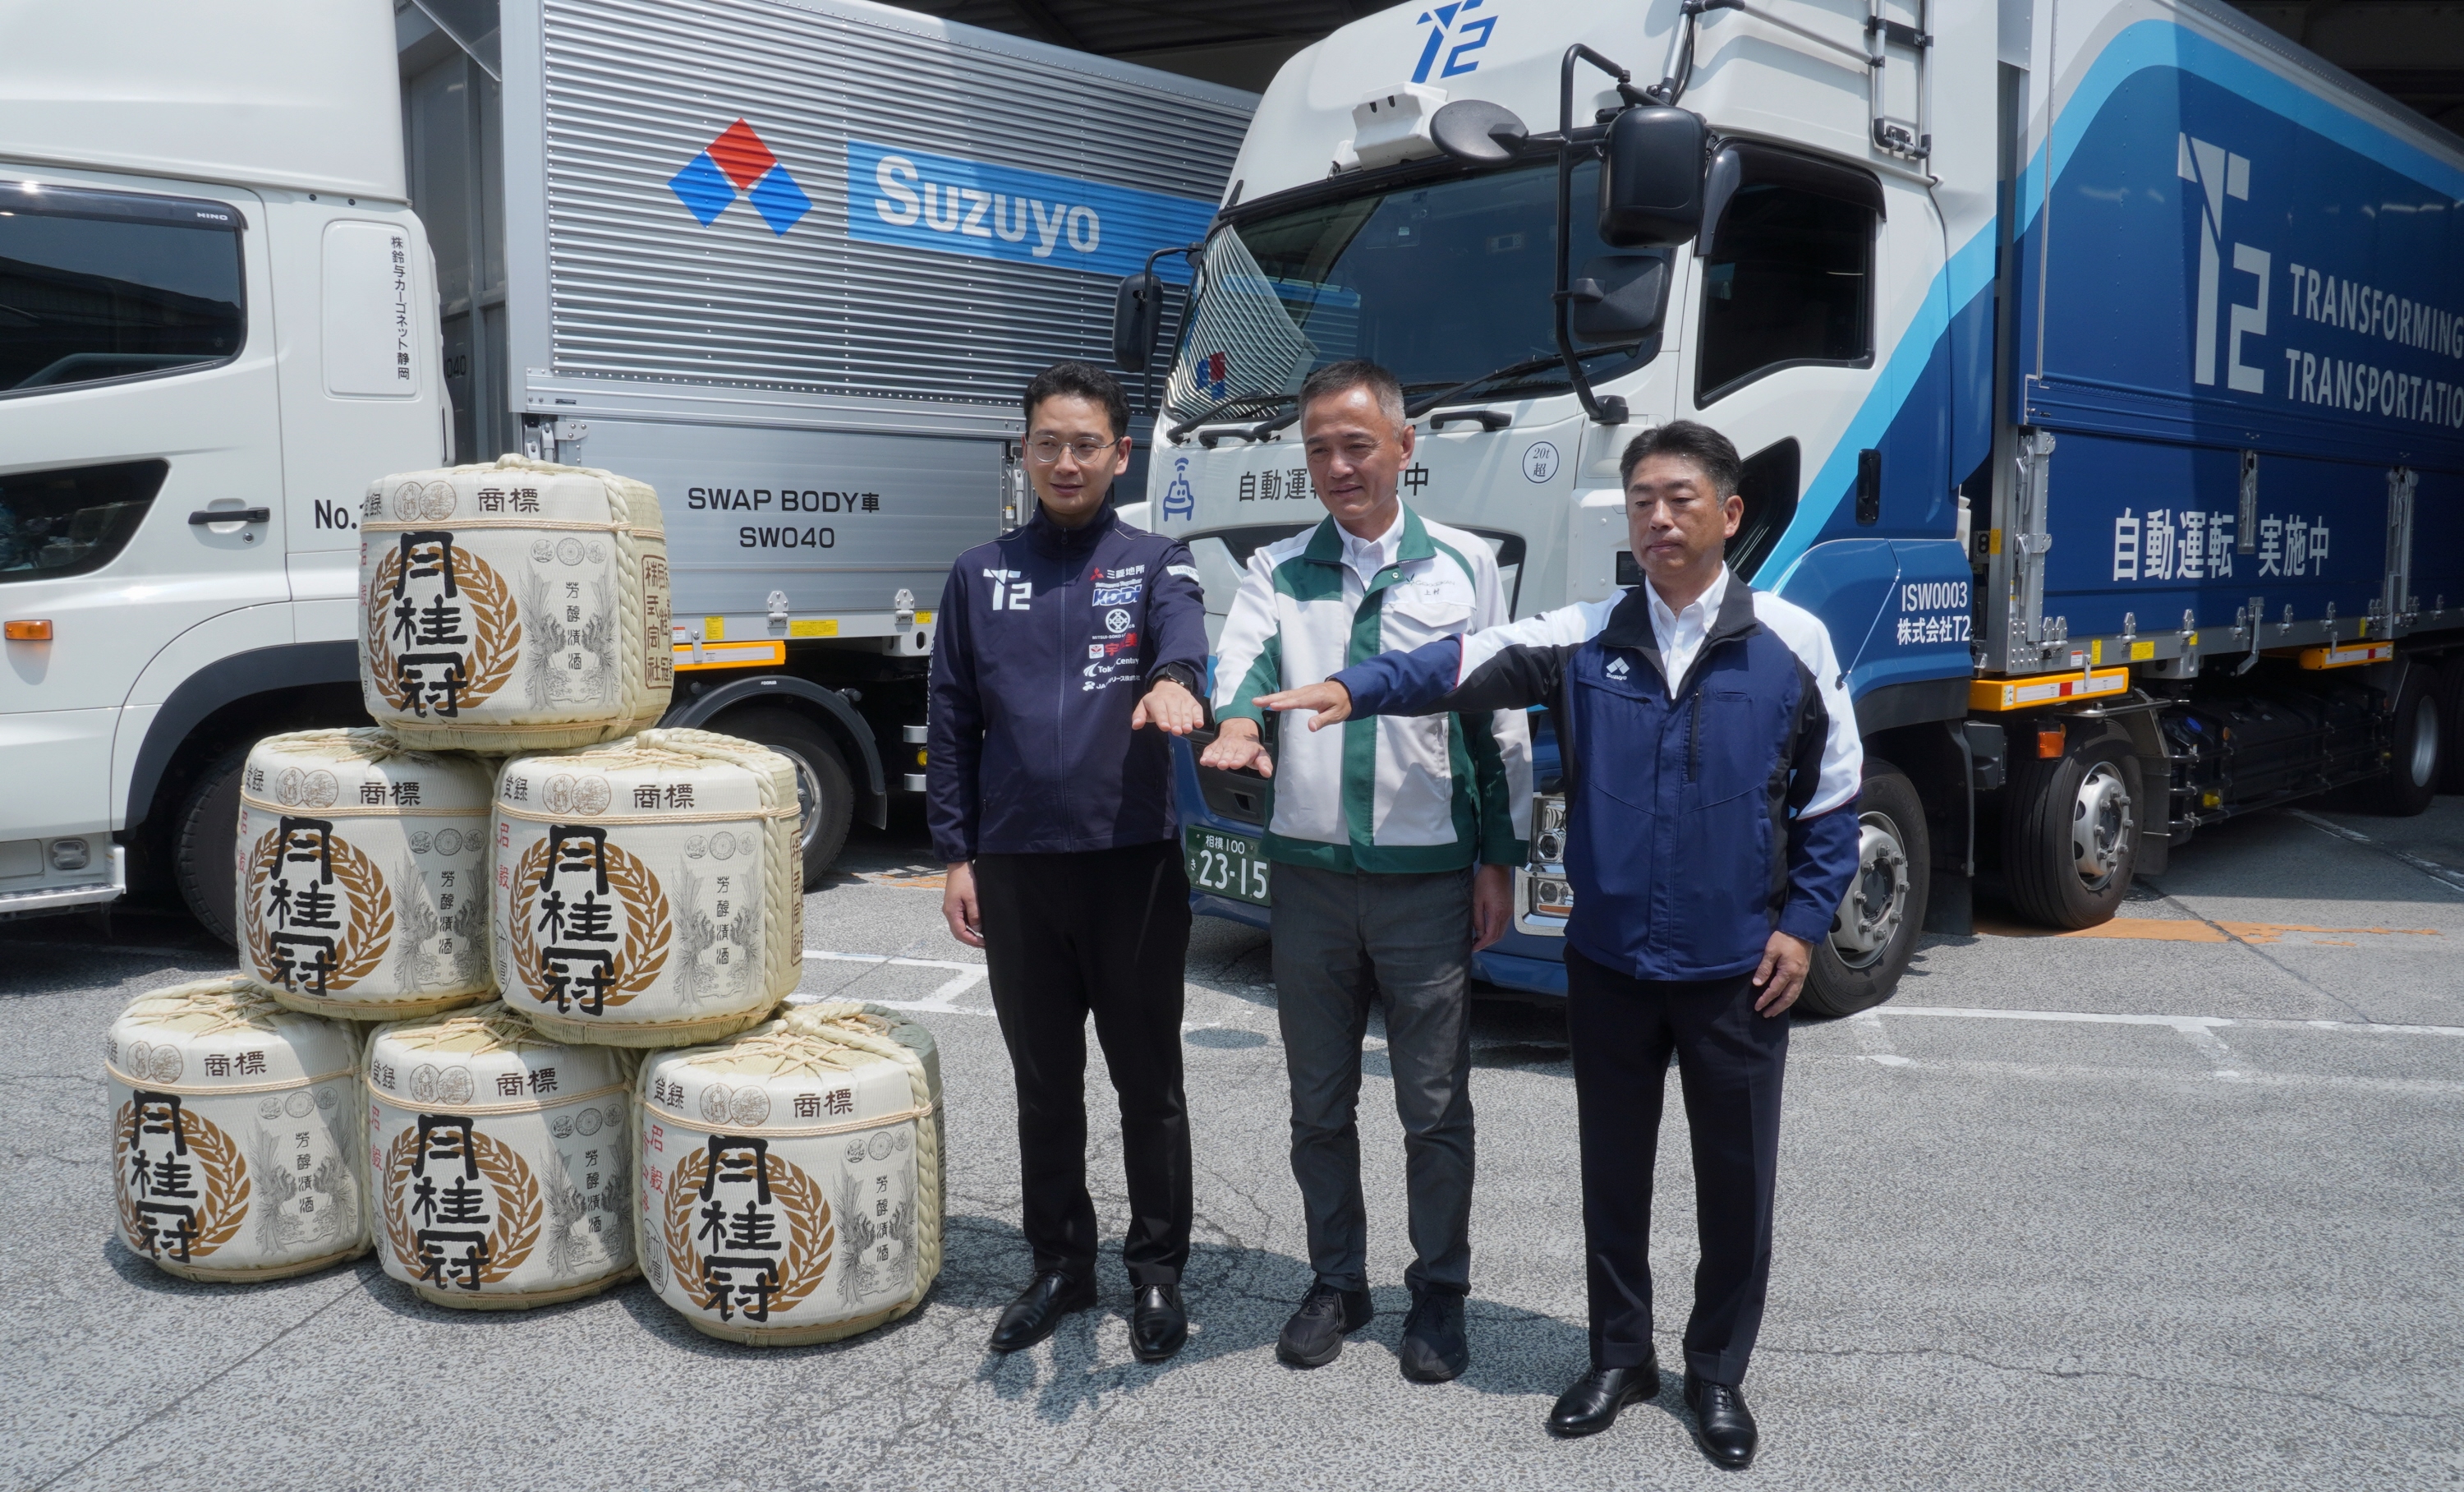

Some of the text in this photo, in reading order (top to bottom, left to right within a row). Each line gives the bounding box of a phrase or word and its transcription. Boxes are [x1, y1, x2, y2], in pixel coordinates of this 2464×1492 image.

[197, 212, 228, 221] HINO
[875, 156, 1100, 258] Suzuyo
[2289, 262, 2464, 359] TRANSFORMING
[444, 354, 467, 380] 040
[1533, 447, 1551, 459] 20t
[1533, 462, 1547, 477] 超
[315, 499, 364, 530] No.
[477, 487, 541, 513] 商標
[687, 487, 880, 513] SWAP BODY車
[739, 527, 835, 548] SW040
[2113, 507, 2330, 582] 自動運転 実施中
[1106, 564, 1145, 578] 三菱地所
[1092, 583, 1142, 606] KDDI
[1901, 581, 1968, 612] ISW0003
[393, 531, 469, 718] 月桂冠
[1896, 615, 1971, 646] 株式会社T2
[360, 781, 422, 806] 商標
[632, 783, 695, 809] 商標
[1190, 850, 1267, 899] き 23-15
[267, 816, 341, 997] 月桂冠
[537, 824, 618, 1016] 月桂冠
[205, 1050, 267, 1077] 商標
[496, 1067, 559, 1097] 商標
[793, 1089, 854, 1118] 商標
[131, 1089, 200, 1264] 月桂冠
[411, 1114, 492, 1292] 月桂冠
[697, 1135, 782, 1323] 月桂冠
